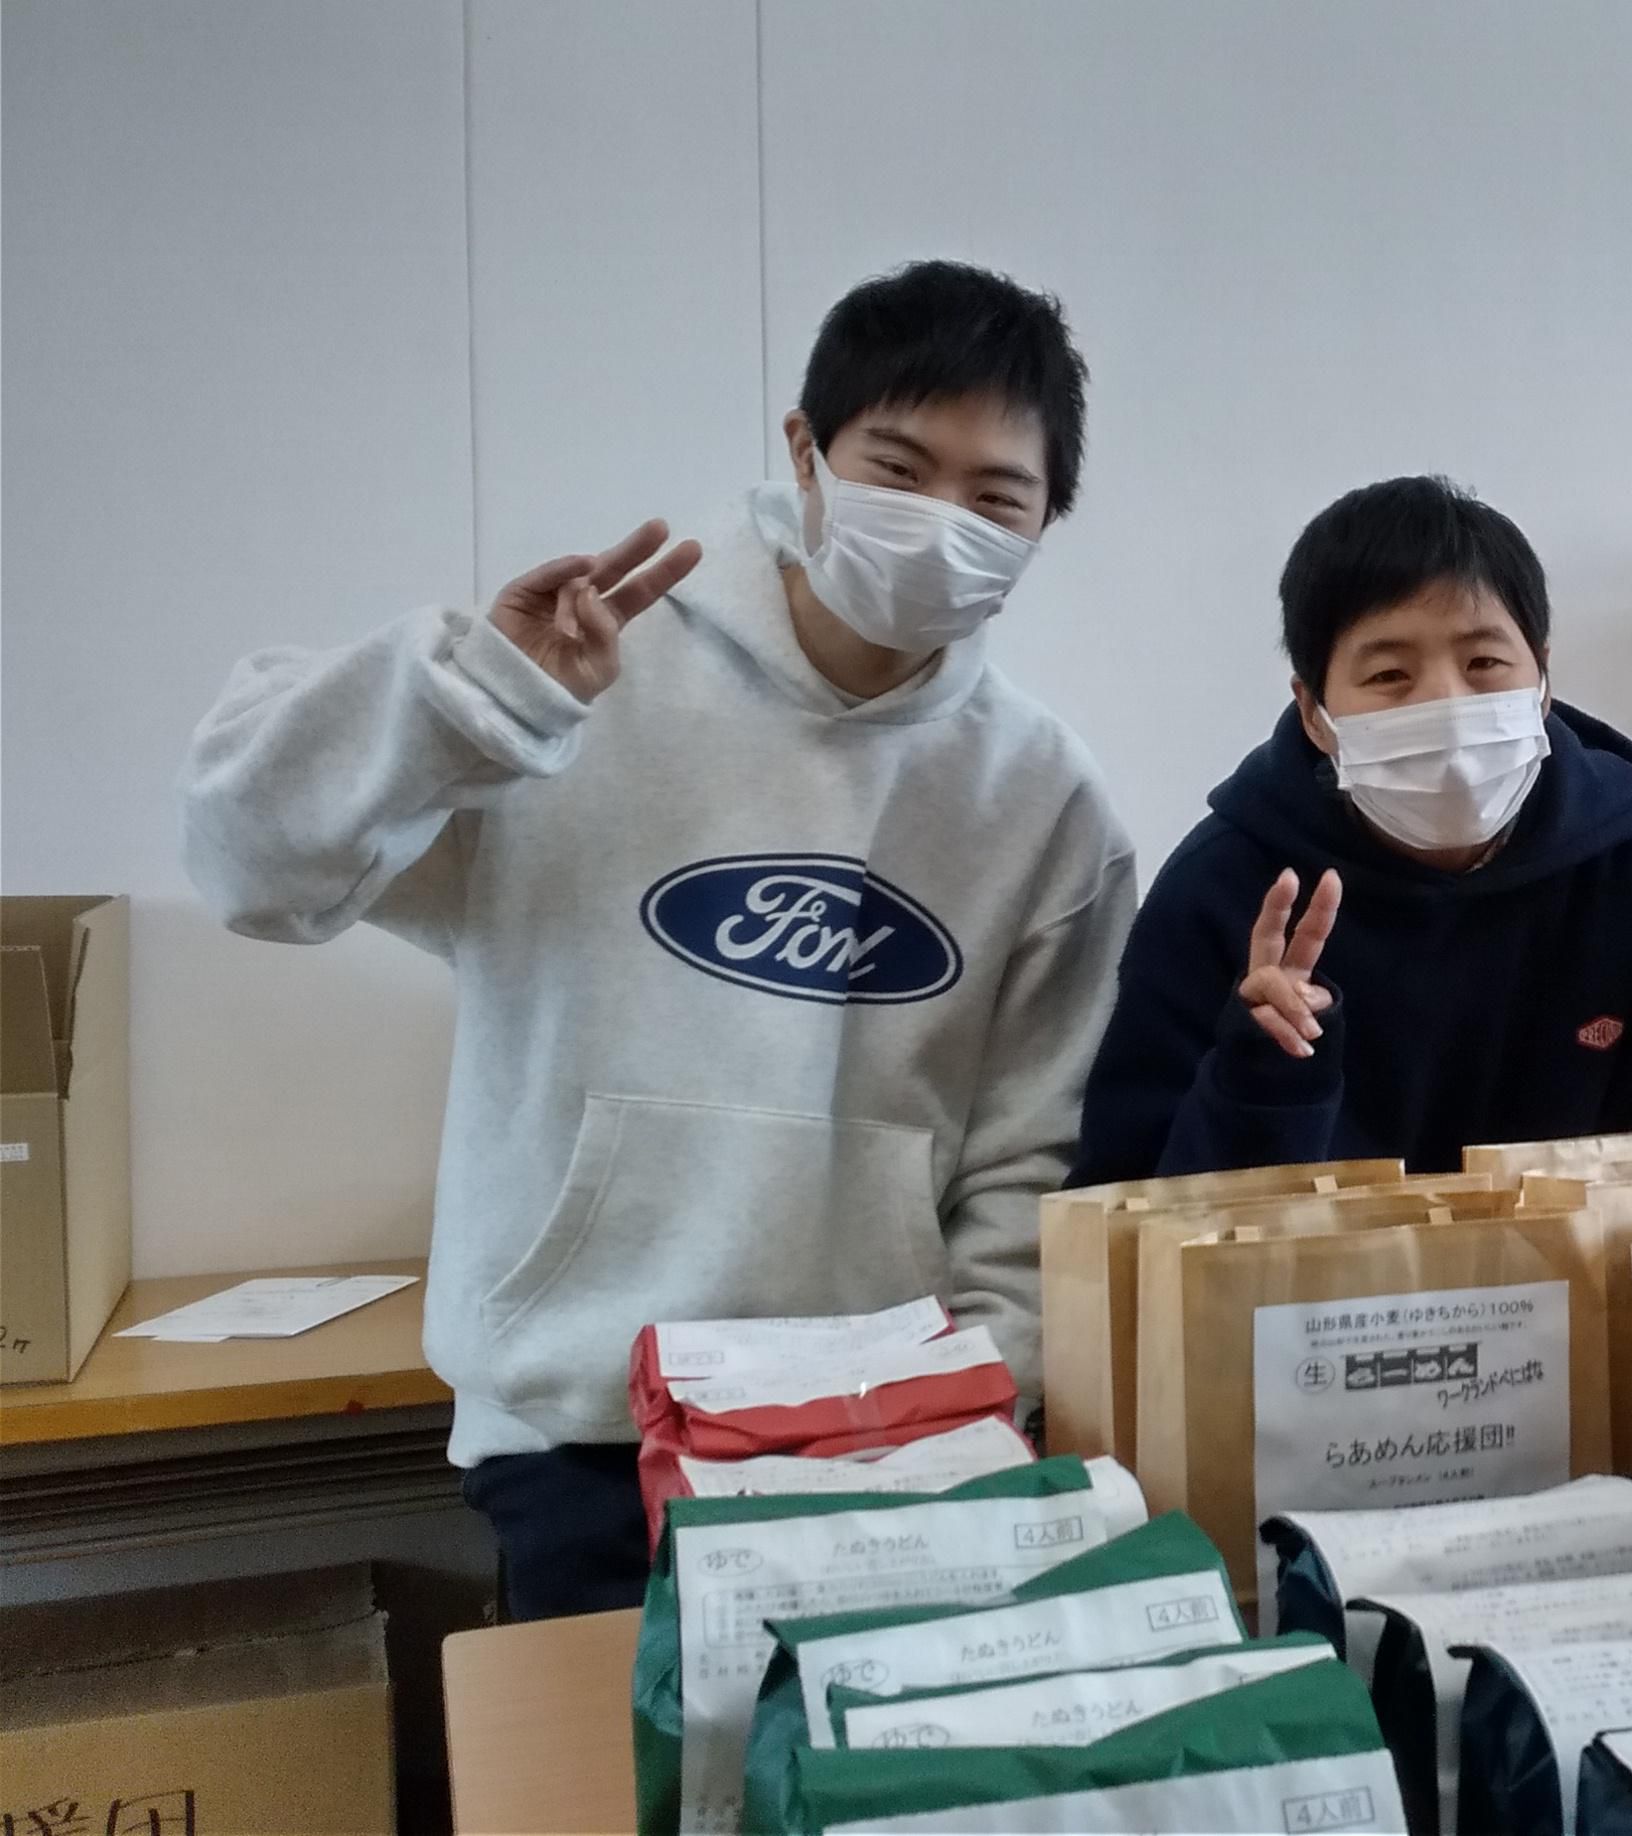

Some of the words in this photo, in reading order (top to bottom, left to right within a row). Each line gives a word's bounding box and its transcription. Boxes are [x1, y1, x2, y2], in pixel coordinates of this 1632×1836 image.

[703, 1550, 753, 1574] ゆで
[832, 1534, 930, 1557] たぬきうどん
[1020, 1523, 1077, 1546] 4人前
[960, 1630, 1061, 1662] たぬきうどん
[1156, 1600, 1211, 1624] 4人前
[1033, 1699, 1144, 1726] たぬきうどん
[1296, 1798, 1363, 1827] 4人前
